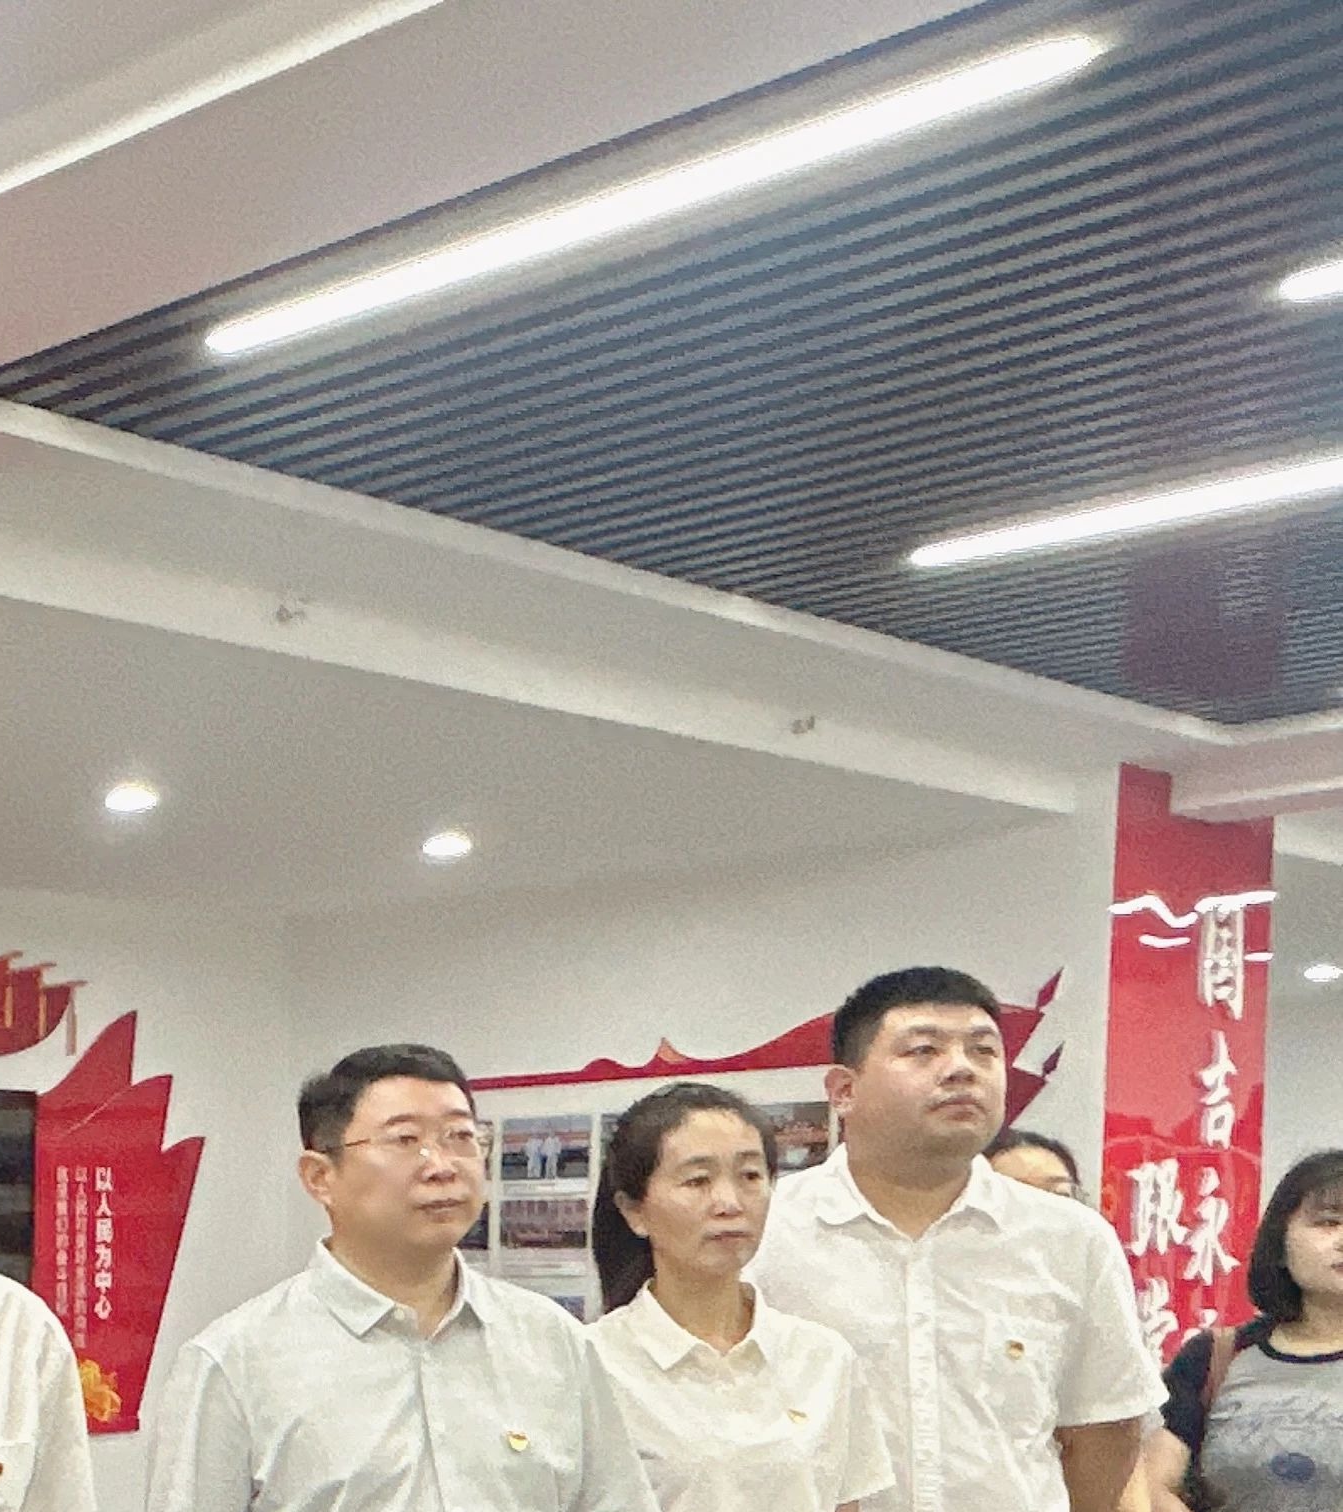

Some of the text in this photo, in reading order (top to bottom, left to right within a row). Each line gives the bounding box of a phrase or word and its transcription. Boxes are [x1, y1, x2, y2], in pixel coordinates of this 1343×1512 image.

[94, 1166, 113, 1320] 以人民为中心
